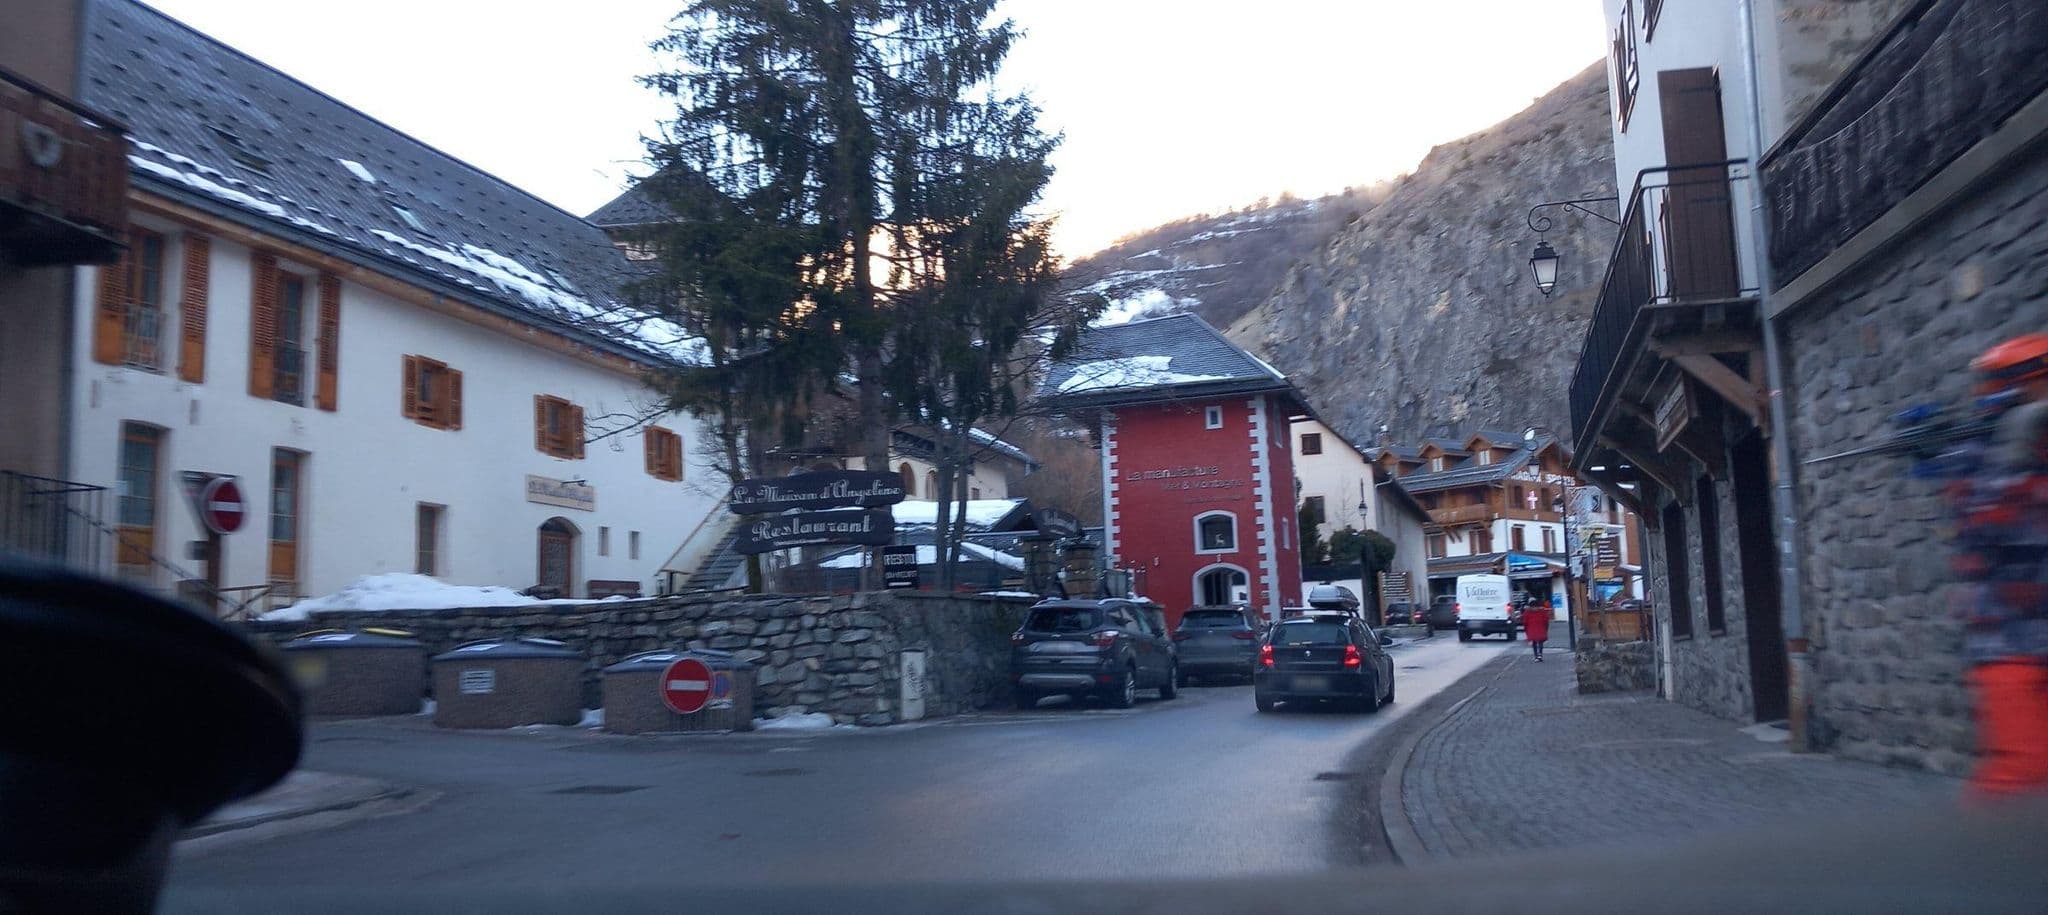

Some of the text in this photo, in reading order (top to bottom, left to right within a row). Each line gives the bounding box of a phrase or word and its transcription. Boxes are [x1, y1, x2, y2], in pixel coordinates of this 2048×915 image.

[1143, 465, 1219, 480] manufacture
[731, 486, 754, 504] La
[756, 485, 818, 503] Maison
[751, 514, 873, 542] Restaurant
